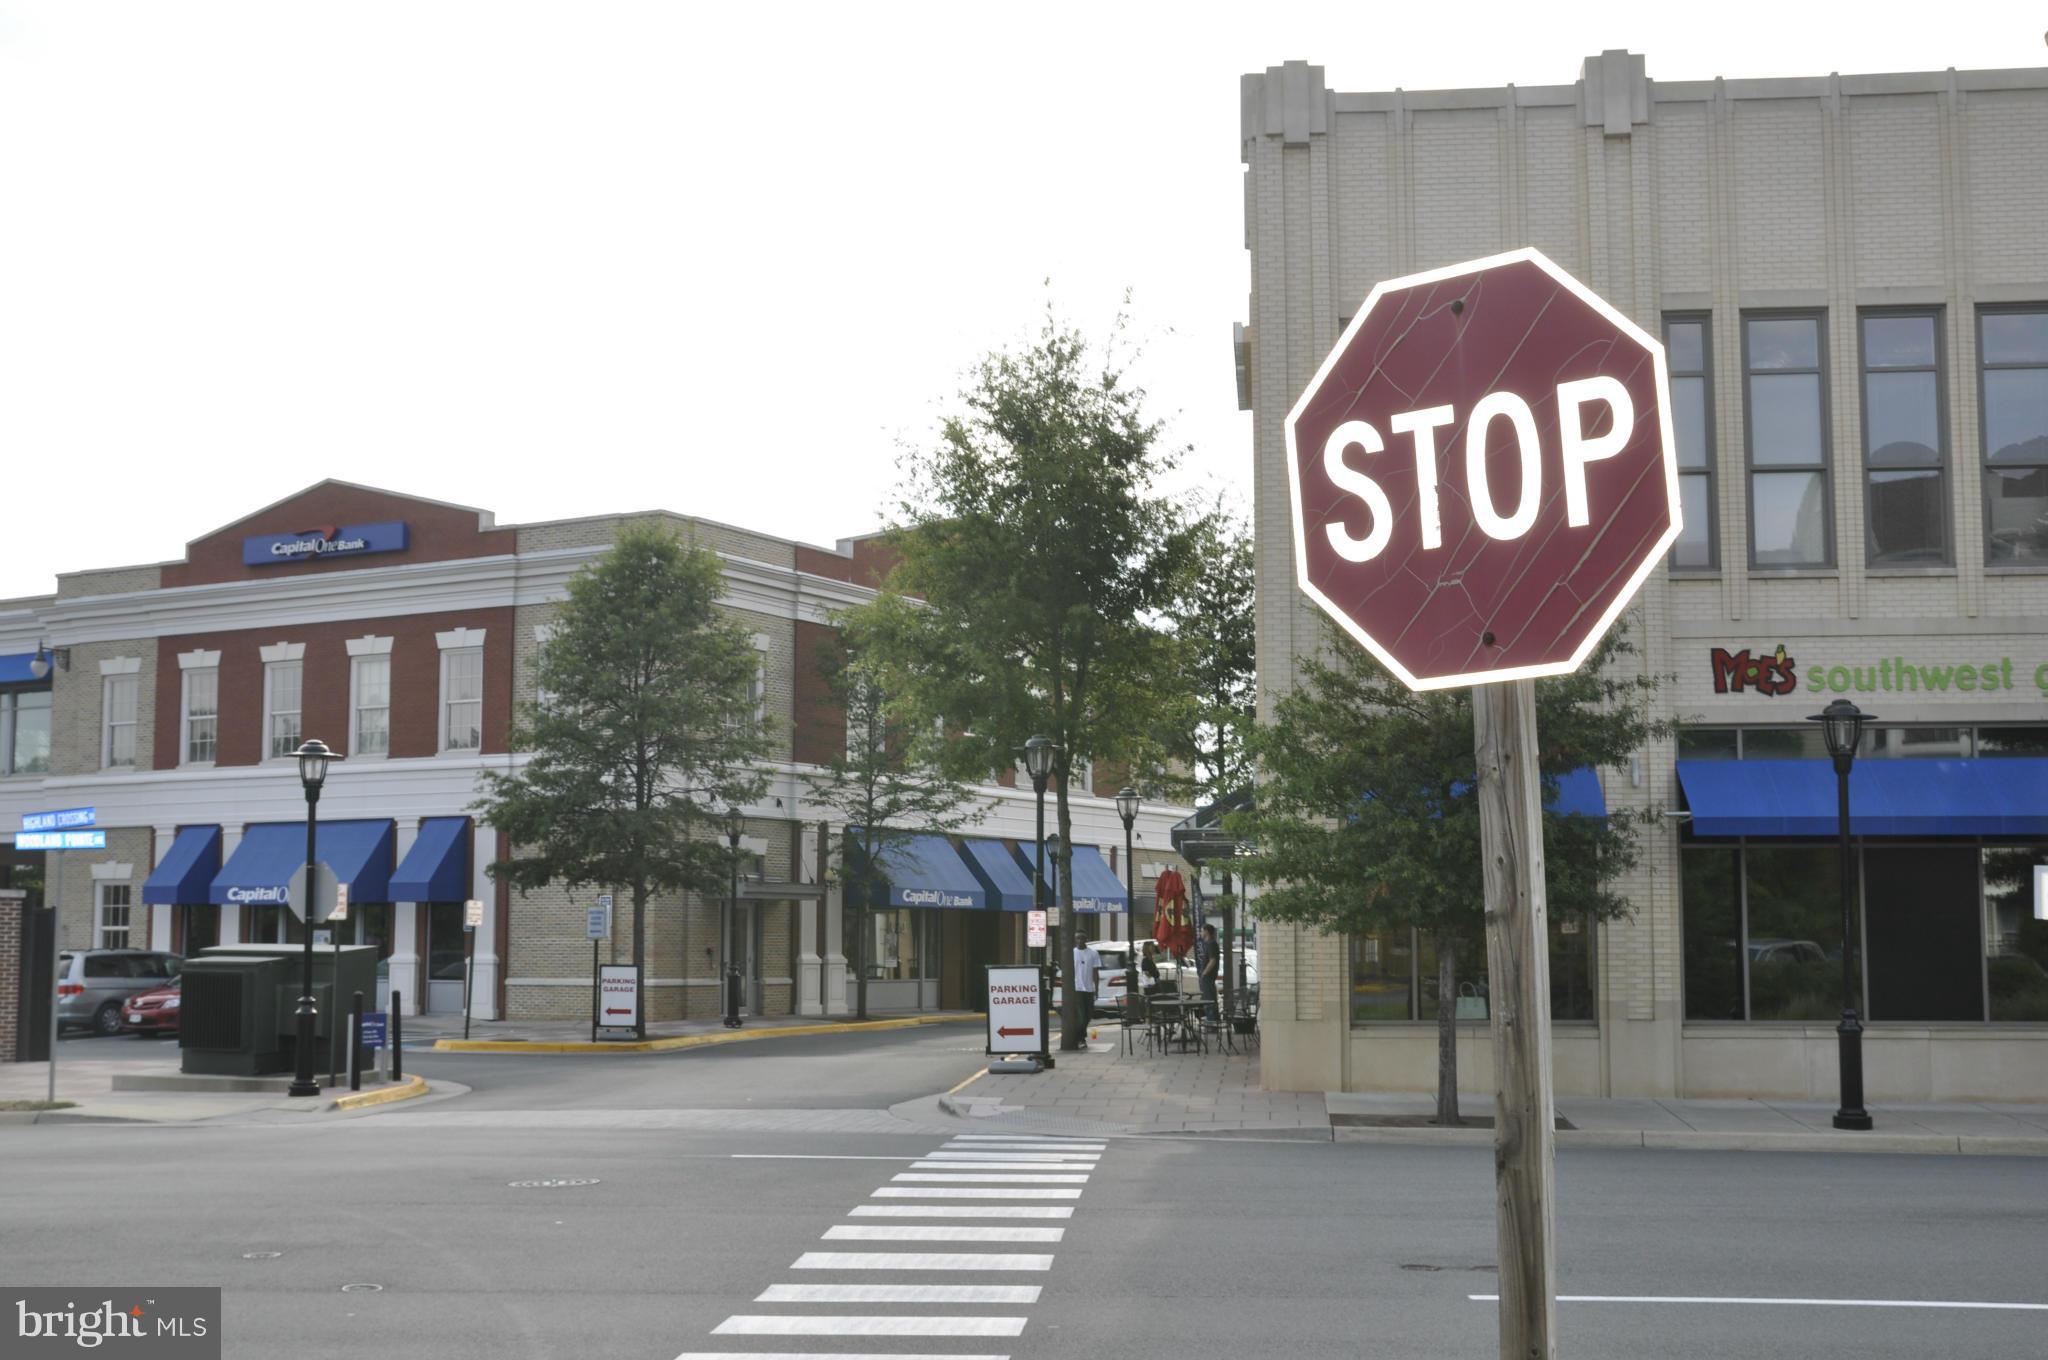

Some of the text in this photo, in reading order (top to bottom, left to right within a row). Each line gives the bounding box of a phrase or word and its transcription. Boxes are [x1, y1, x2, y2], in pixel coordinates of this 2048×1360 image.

[1324, 376, 1634, 563] STOP
[337, 538, 365, 551] Bank
[1806, 657, 2014, 693] southwest
[23, 813, 56, 831] HIGHLAND
[57, 810, 89, 827] CROSSING
[953, 896, 974, 906] Bank
[1107, 902, 1122, 912] Bank
[990, 984, 1038, 993] PARKING
[992, 996, 1036, 1005] GARAGE
